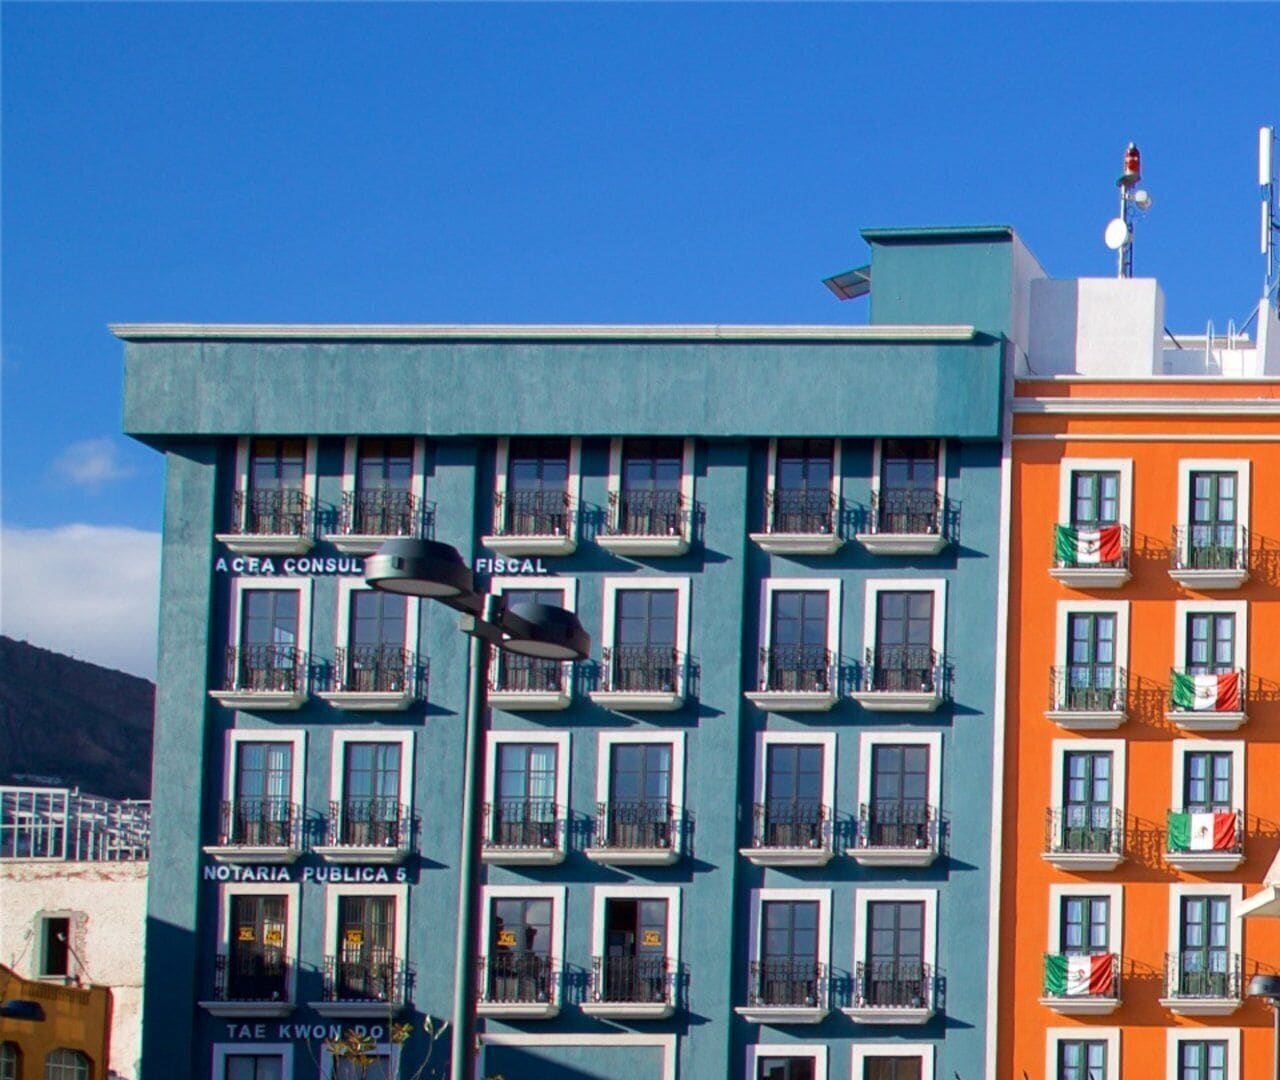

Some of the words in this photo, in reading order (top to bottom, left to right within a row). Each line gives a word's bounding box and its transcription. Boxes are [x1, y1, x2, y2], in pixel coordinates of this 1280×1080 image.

[284, 558, 362, 573] CONSUL
[476, 558, 548, 574] FISCAL
[204, 866, 290, 881] NOTARIA
[303, 867, 389, 882] PUBLICA
[395, 867, 406, 882] 5
[226, 1023, 266, 1039] TAE
[279, 1024, 342, 1039] KWON
[355, 1024, 384, 1039] DO
